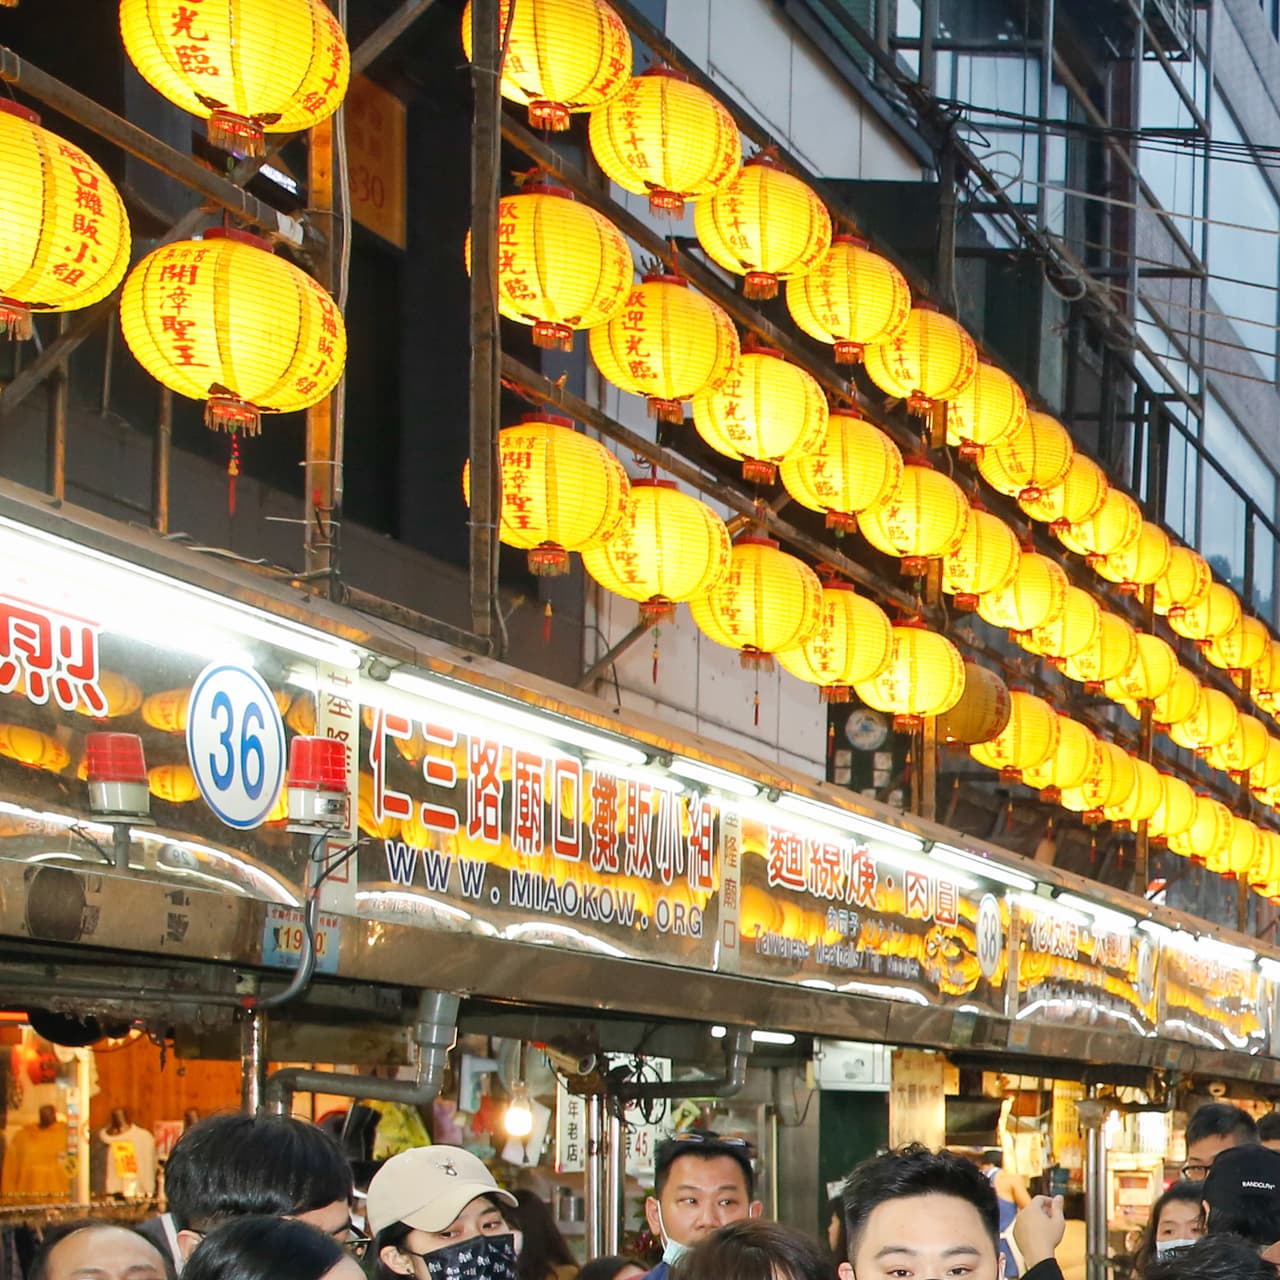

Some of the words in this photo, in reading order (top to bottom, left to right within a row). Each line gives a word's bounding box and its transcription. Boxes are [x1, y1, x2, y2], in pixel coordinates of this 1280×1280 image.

[171, 2, 219, 77] 光臨
[158, 263, 210, 369] 開漳聖王
[501, 451, 539, 531] 開漳聖王
[209, 690, 266, 801] 36
[369, 704, 714, 891] 仁三路廟口攤販小組
[980, 910, 998, 951] 38
[634, 1132, 649, 1159] 45
